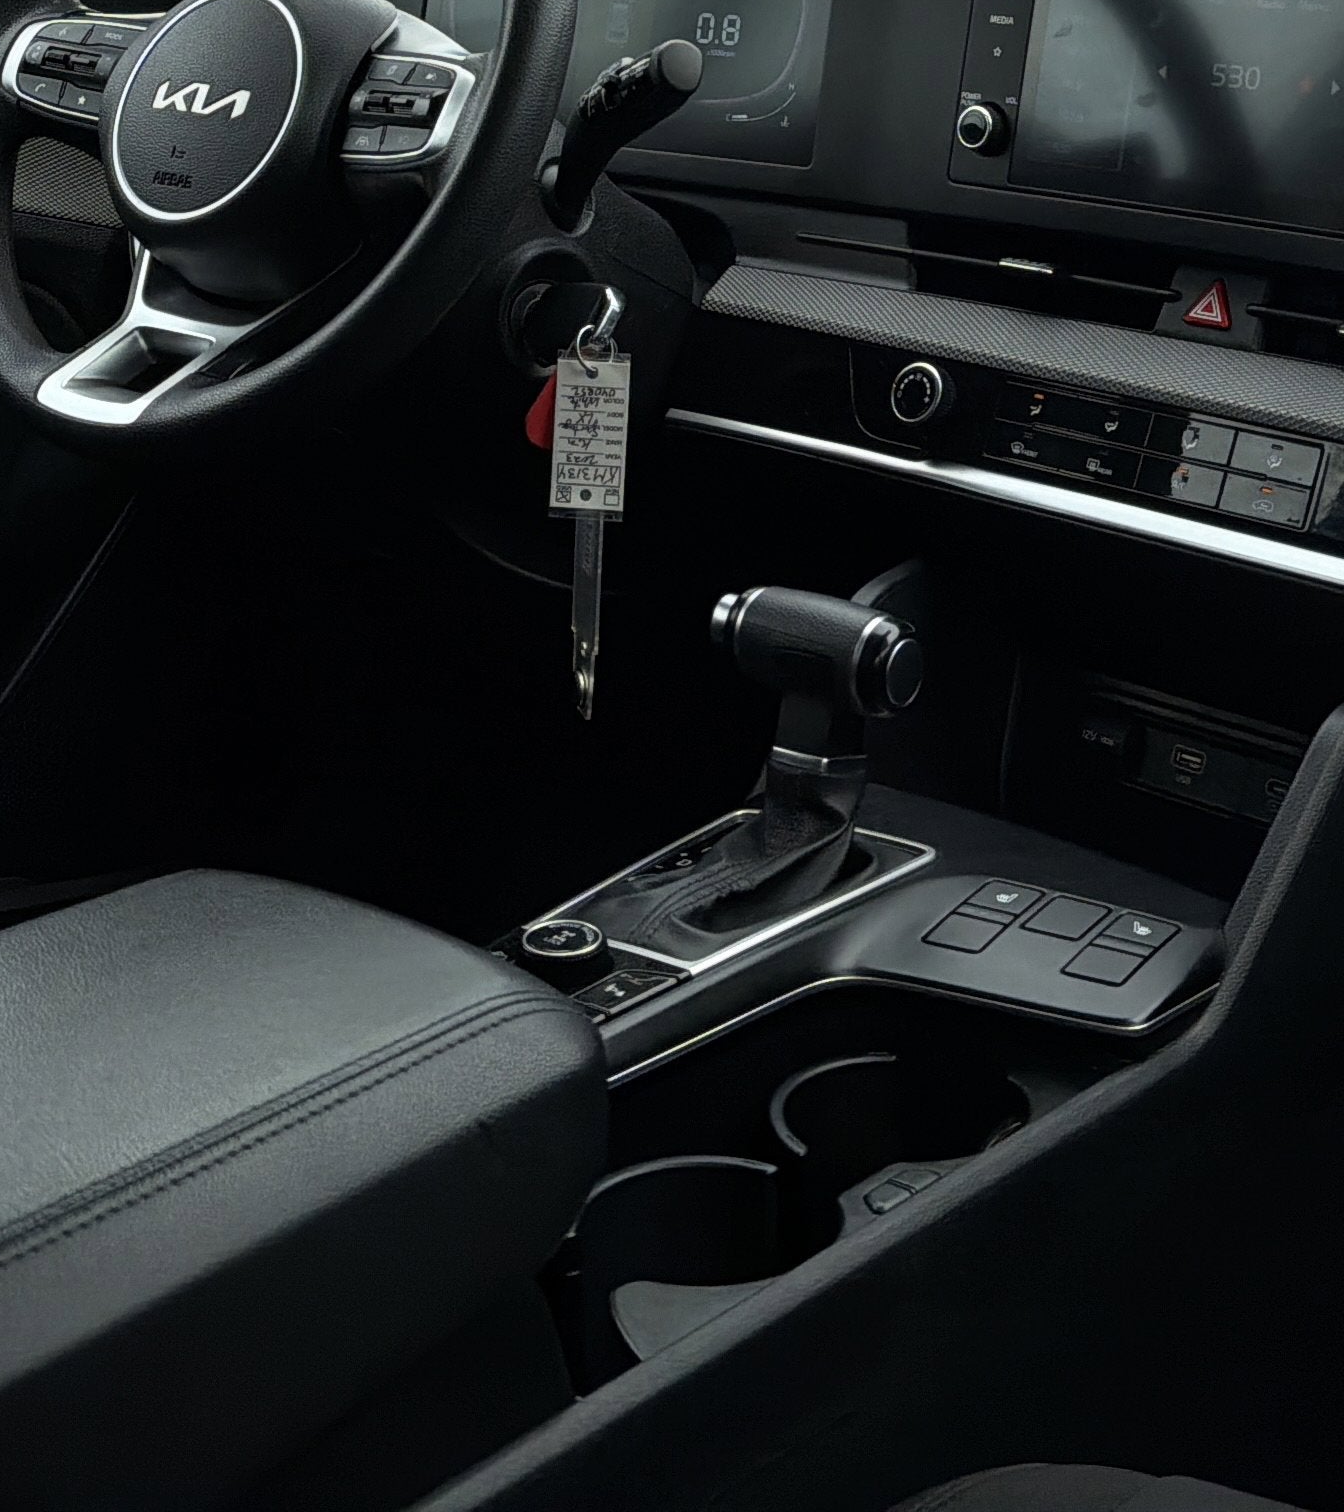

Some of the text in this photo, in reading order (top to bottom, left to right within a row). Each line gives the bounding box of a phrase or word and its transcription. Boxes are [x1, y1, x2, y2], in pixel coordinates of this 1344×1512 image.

[696, 12, 741, 46] 0.8
[989, 14, 1014, 24] MEDIA
[1210, 64, 1261, 90] 530
[152, 79, 251, 119] KIA
[558, 465, 619, 484] KM3134
